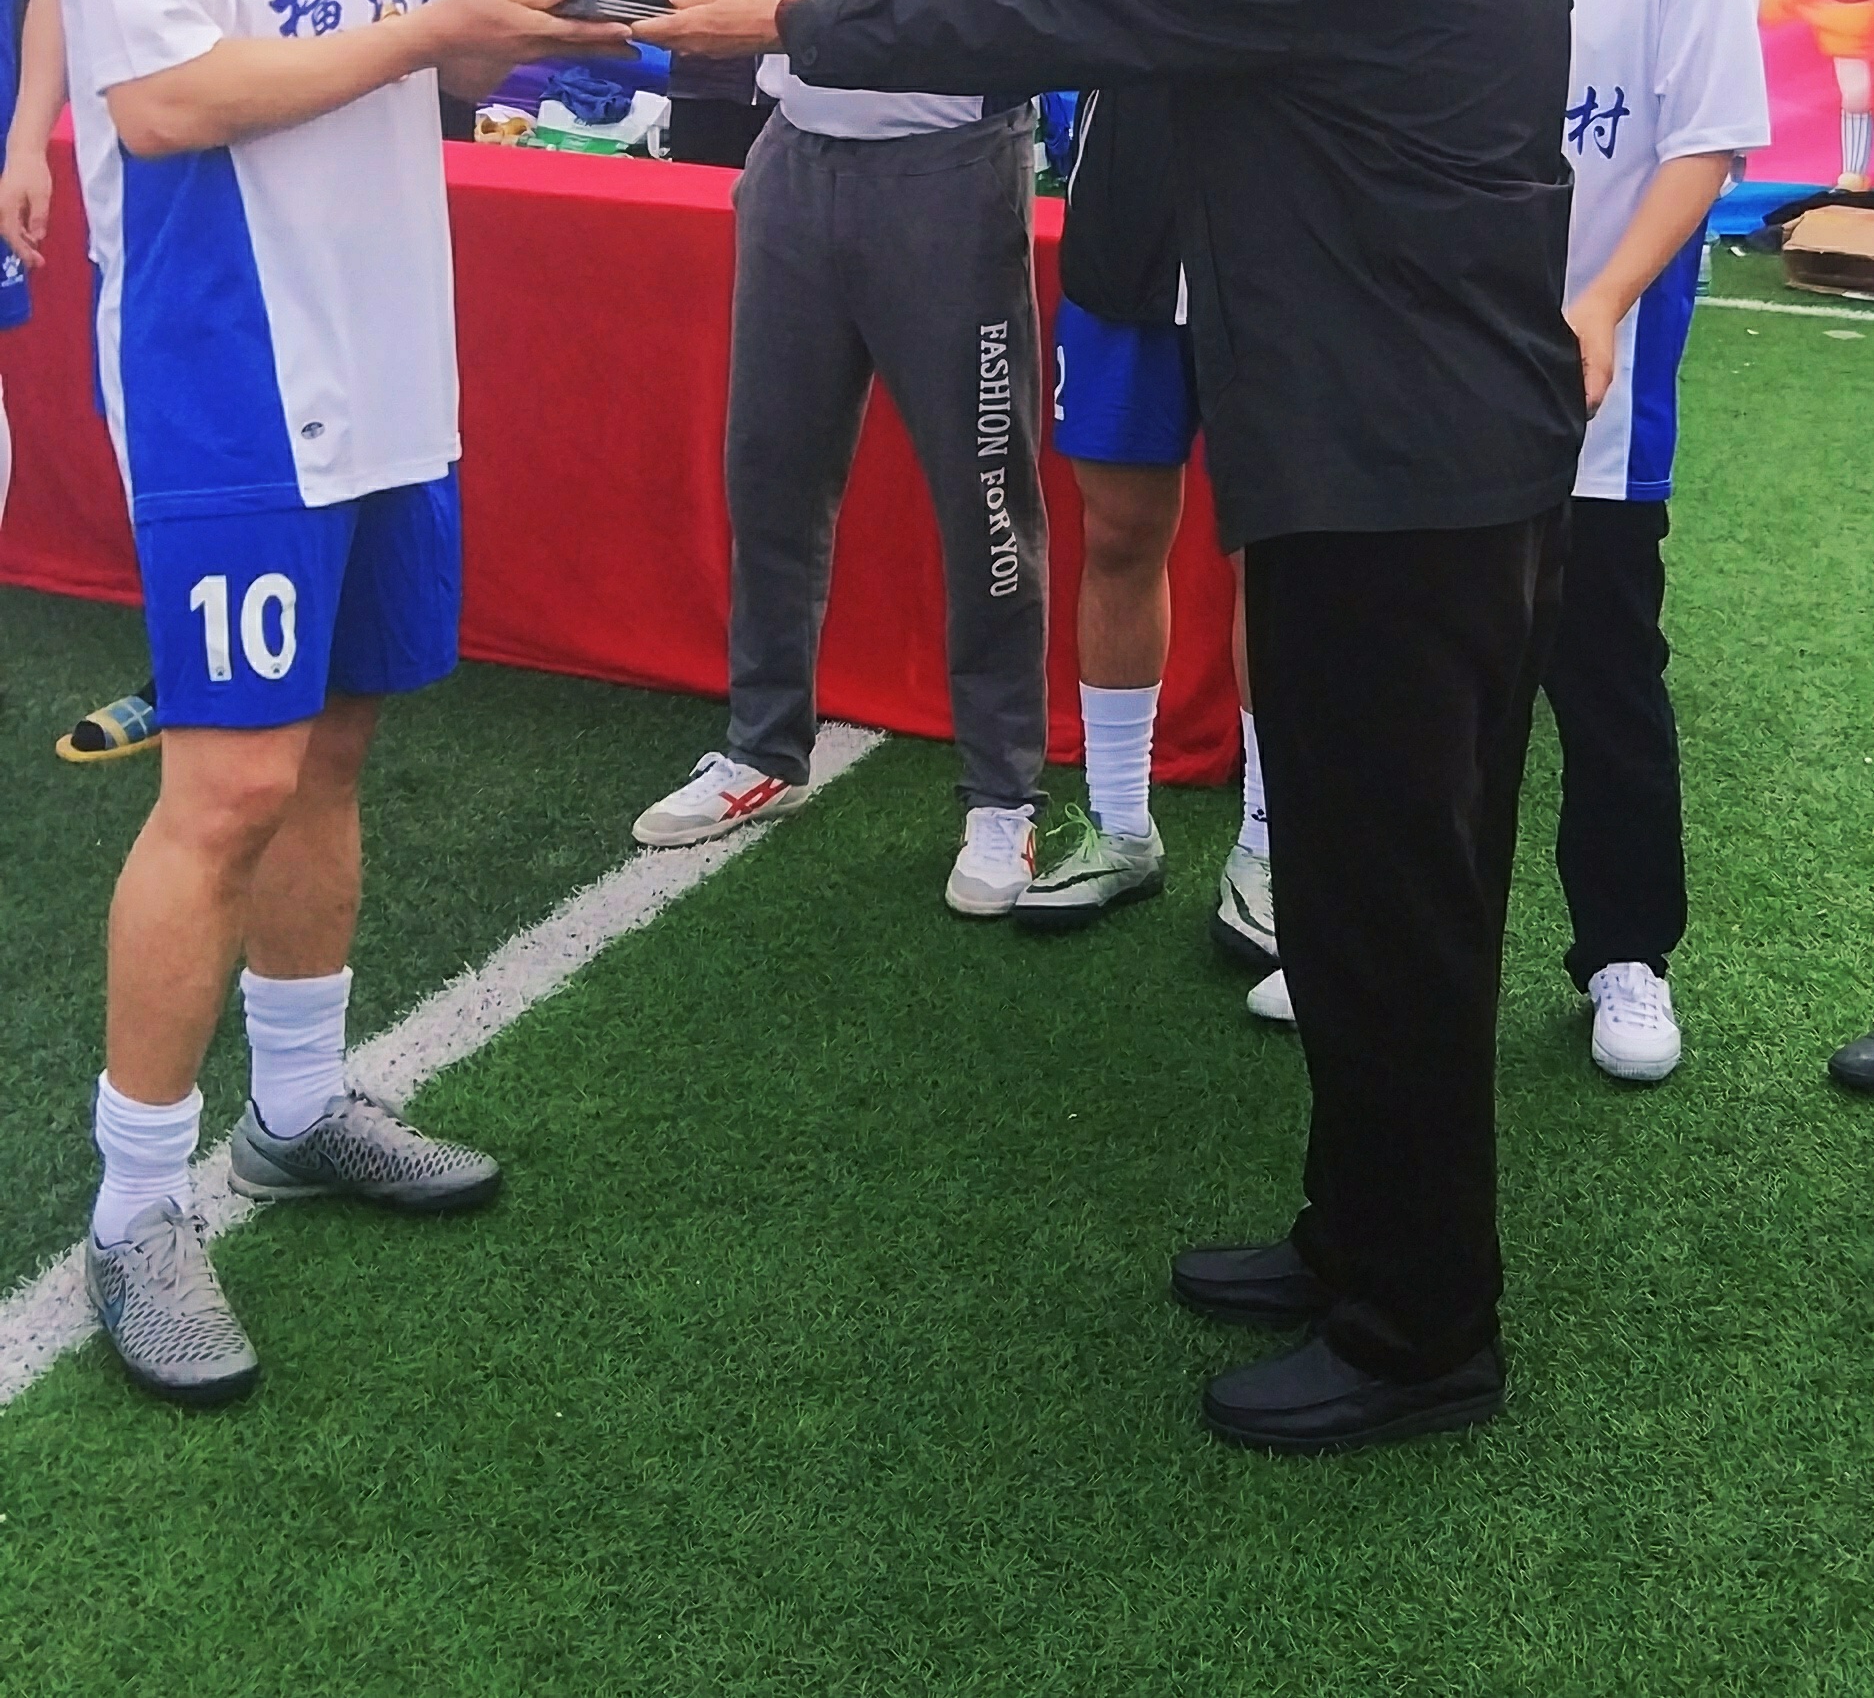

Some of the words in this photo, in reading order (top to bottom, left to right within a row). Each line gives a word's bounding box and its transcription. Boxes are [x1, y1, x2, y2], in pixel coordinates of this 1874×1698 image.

[1565, 86, 1630, 159] 村
[976, 320, 1011, 458] FASHION
[980, 466, 1011, 535] FOR
[989, 532, 1019, 598] YOU
[189, 572, 298, 683] 10
